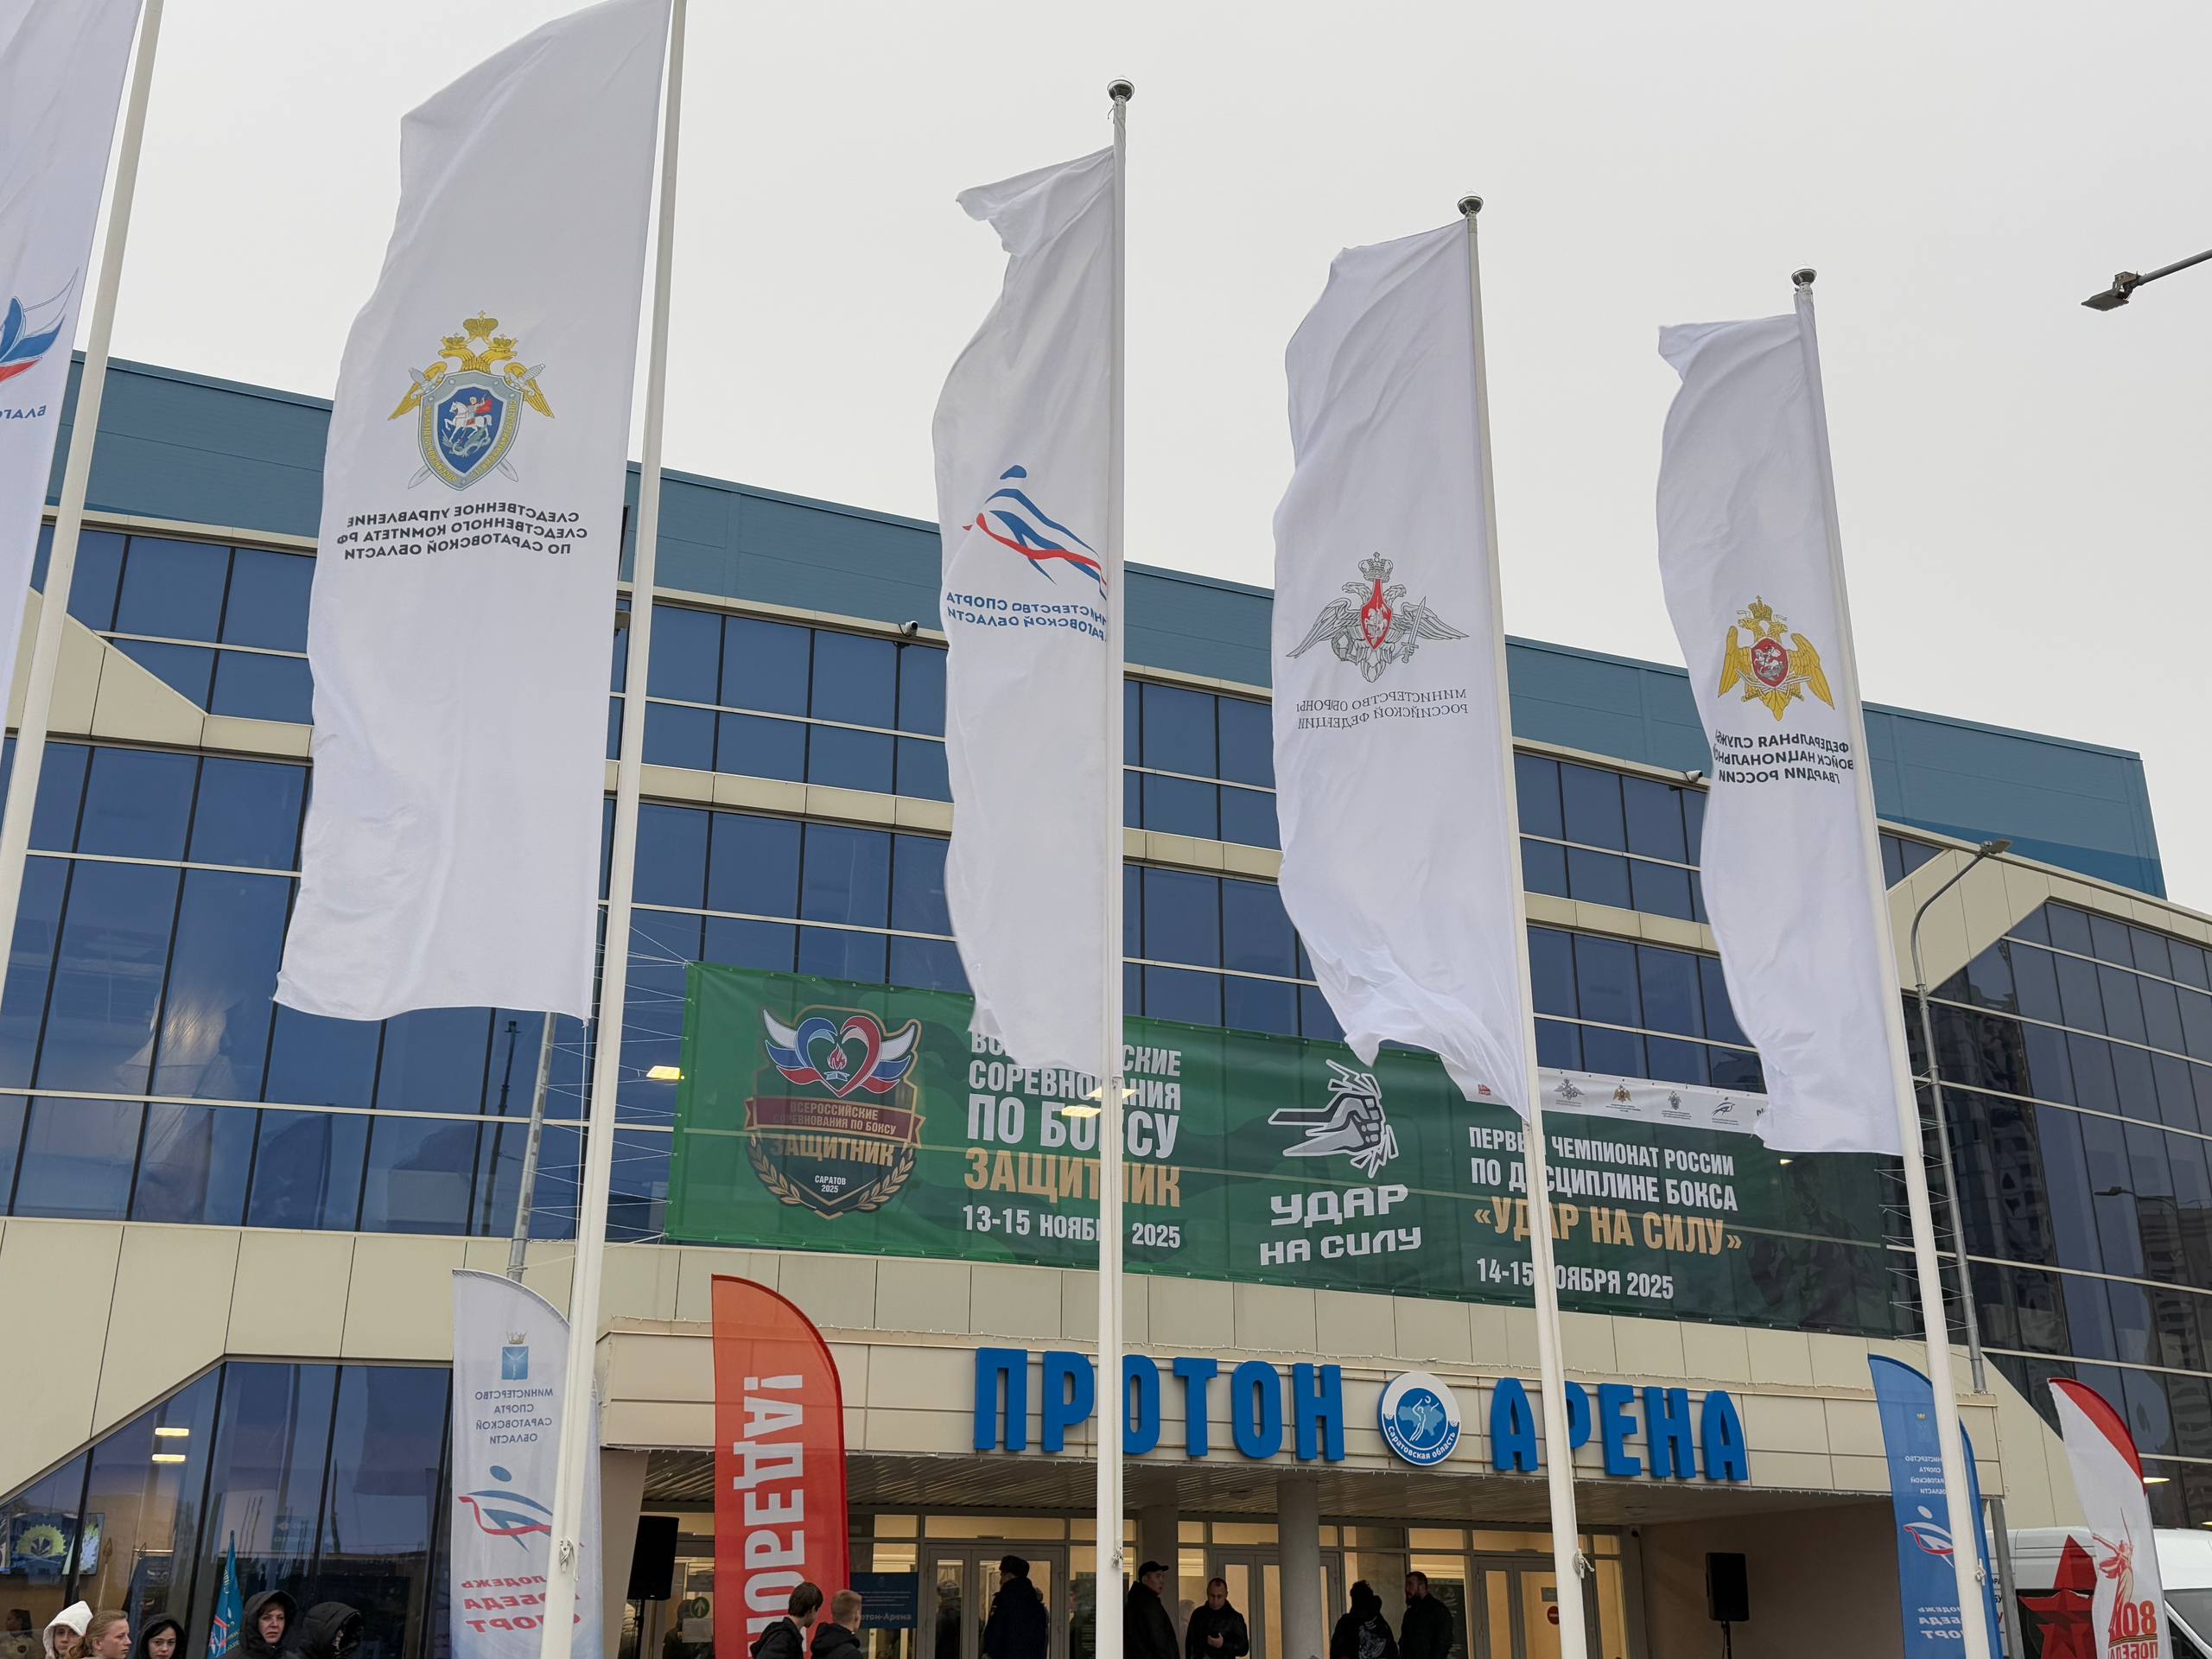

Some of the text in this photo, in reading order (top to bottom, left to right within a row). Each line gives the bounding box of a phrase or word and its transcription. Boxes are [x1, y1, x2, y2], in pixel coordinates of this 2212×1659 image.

[790, 1101, 879, 1121] ВСЕРОССИЙСКИЕ
[850, 1122, 862, 1131] ПО
[865, 1122, 897, 1135] БОКСУ
[967, 1093, 1180, 1159] ПО БОСУ
[770, 1134, 895, 1166] ЗАЩИТНИК
[1551, 1135, 1659, 1168] ЧЕМПИОНАТ
[1664, 1148, 1735, 1176] РОССИИ
[815, 1175, 846, 1185] САРАТОВ
[821, 1184, 839, 1193] 2025
[1471, 1157, 1738, 1211] ПО ДСЦИПЛИНЕ БОКСА
[963, 1205, 1031, 1236] 13-15
[1132, 1223, 1181, 1248] 2025
[1270, 1184, 1408, 1228] УДАР
[1260, 1226, 1421, 1266] НА СИЛУ
[1589, 1205, 1635, 1247] НА
[1643, 1211, 1743, 1255] СИЛУ»
[1476, 1258, 1675, 1300] 14-15 ОЯБРЯ 2025
[973, 1347, 1345, 1461] ПРОТОН
[1388, 1426, 1456, 1459] Саратовская область
